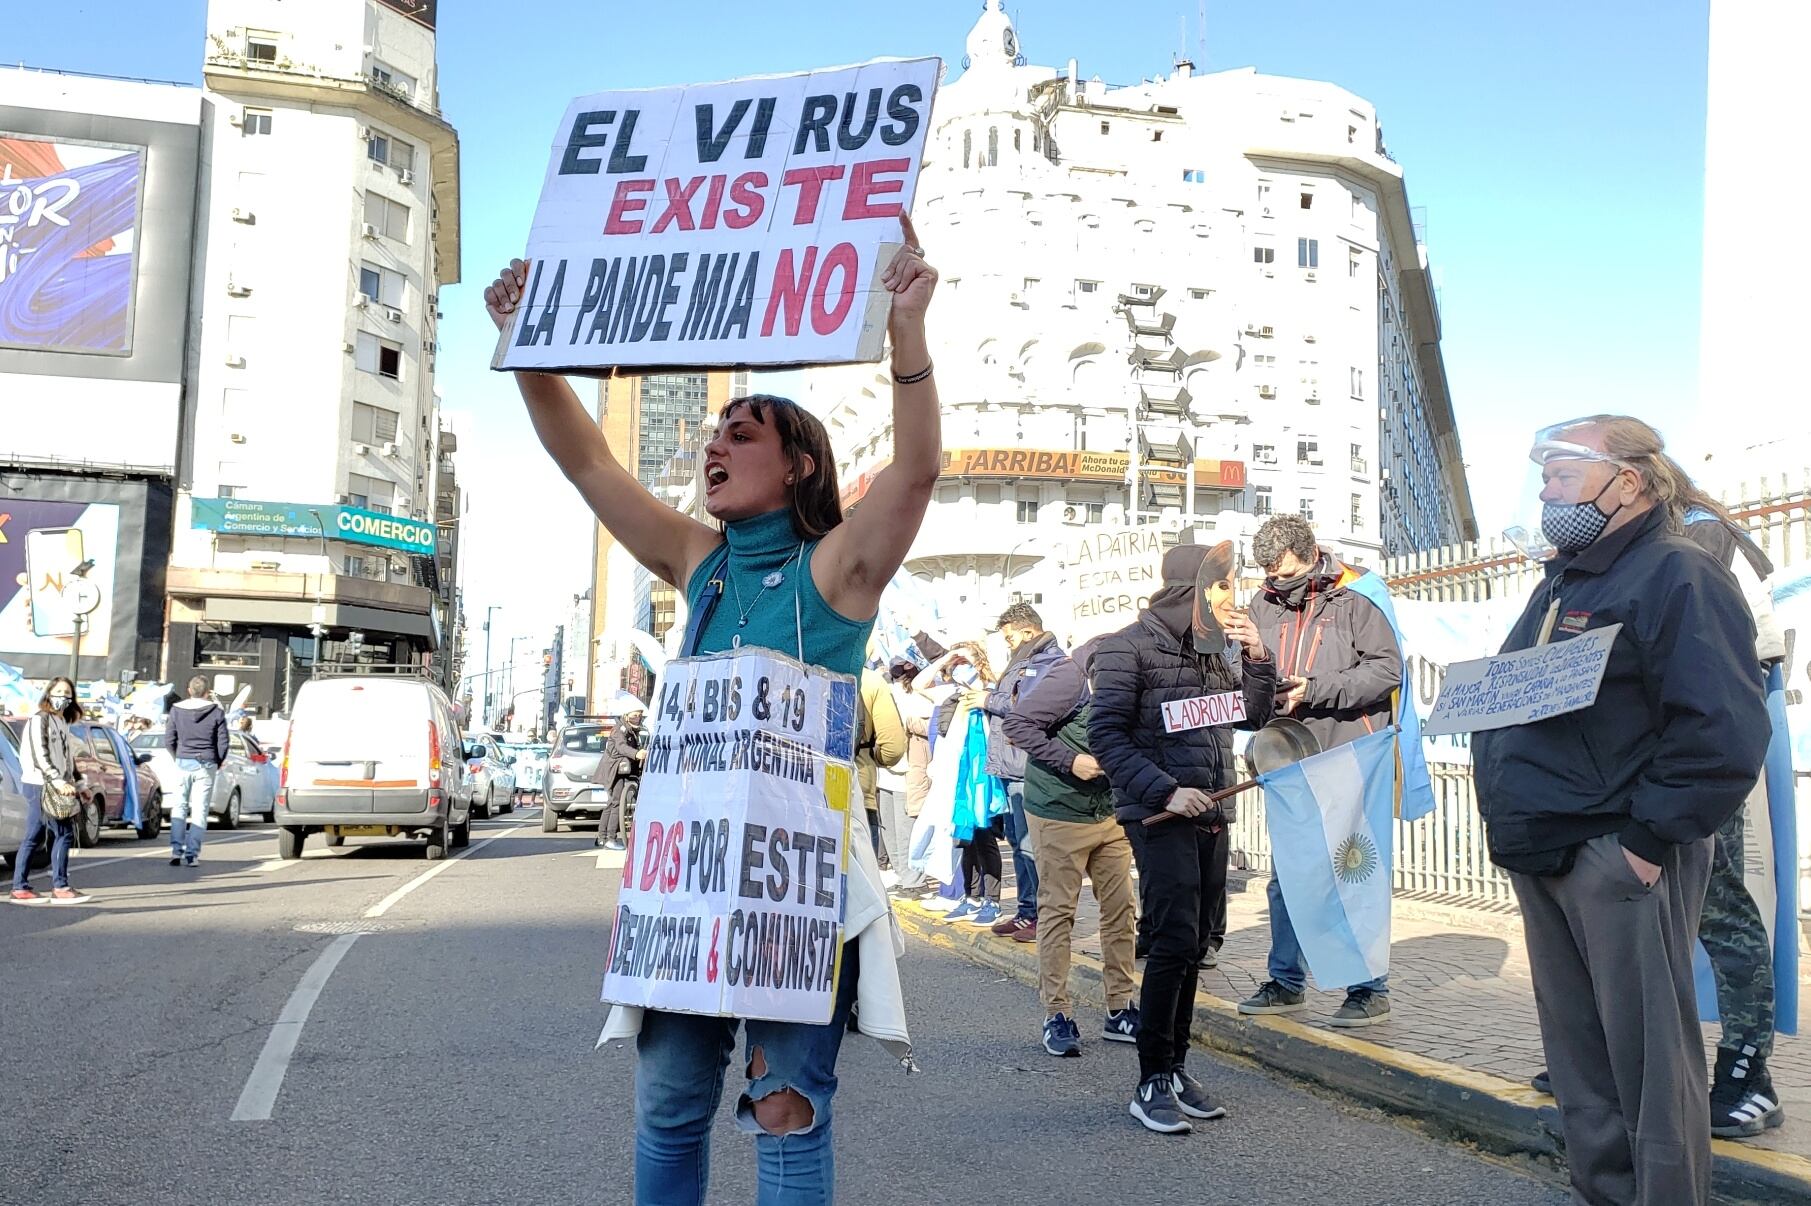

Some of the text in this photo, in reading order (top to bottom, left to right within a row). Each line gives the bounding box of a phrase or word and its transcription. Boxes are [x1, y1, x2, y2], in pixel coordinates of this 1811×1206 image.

[559, 109, 649, 175] EL
[603, 158, 911, 235] EXISTE
[515, 259, 567, 346] LA
[760, 242, 859, 338] NO
[964, 450, 1079, 475] ¡ARRIBA!
[1082, 455, 1107, 465] Ahora
[1109, 457, 1118, 466] tu
[223, 521, 271, 532] Comercio
[272, 525, 279, 534] y
[224, 511, 285, 523] Argentina de
[338, 511, 434, 546] COMERCIO
[1128, 564, 1153, 582] EN
[703, 676, 742, 723] BIS
[752, 676, 771, 722] &
[781, 684, 806, 733] 19
[1166, 693, 1246, 730] LADRONA
[729, 729, 815, 785] ARGENTINA
[685, 818, 729, 894] POR
[739, 822, 836, 909] ESTE
[707, 917, 720, 984] &
[725, 908, 838, 992] COMUNISTA
